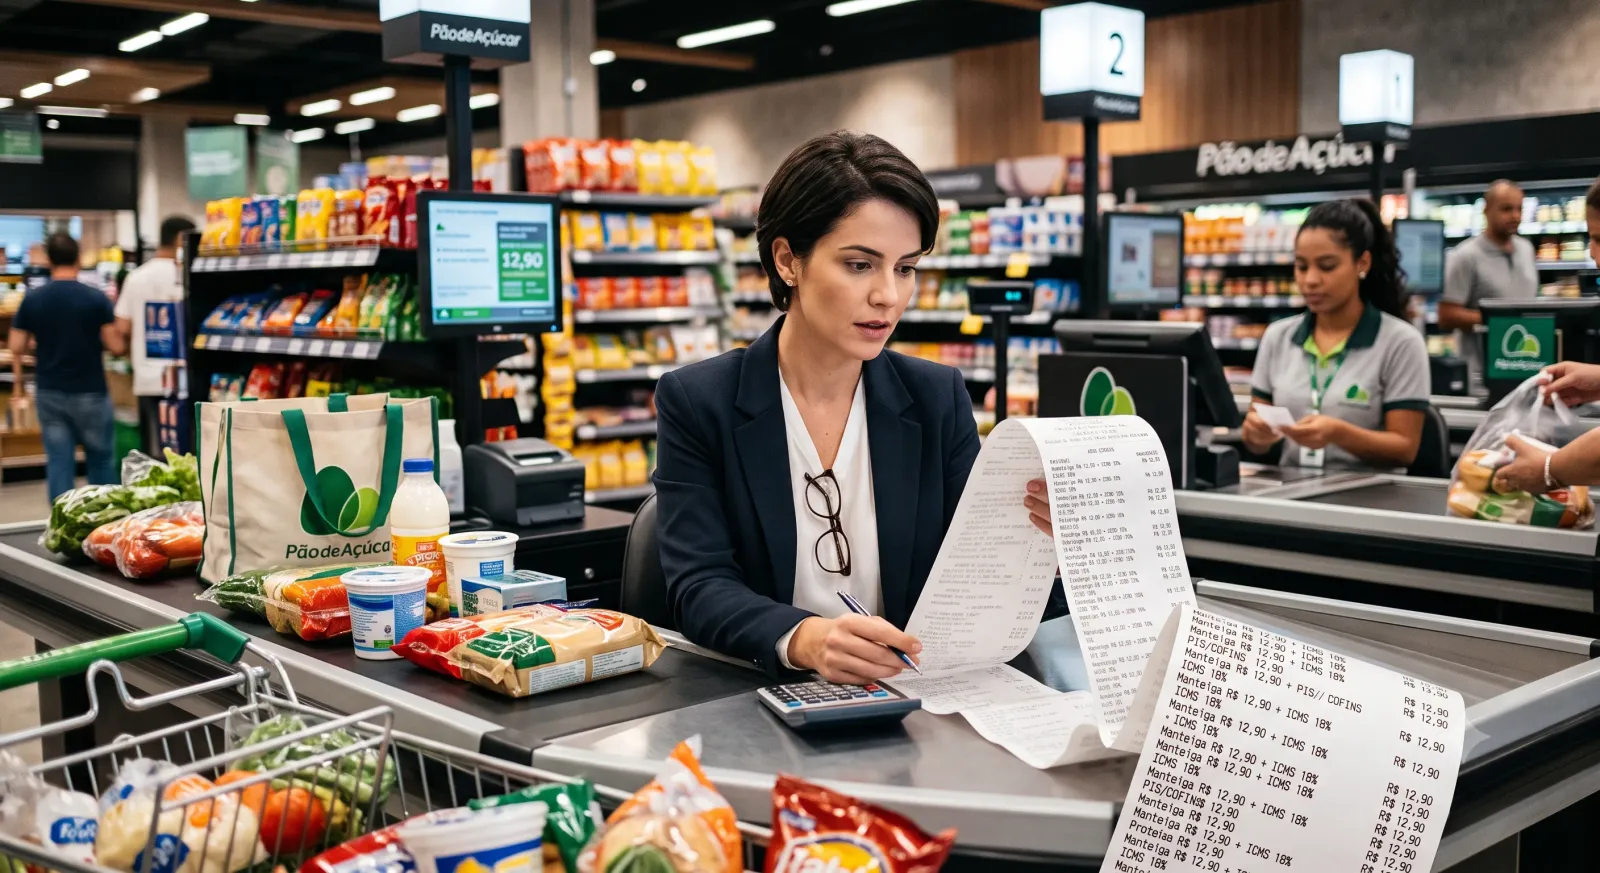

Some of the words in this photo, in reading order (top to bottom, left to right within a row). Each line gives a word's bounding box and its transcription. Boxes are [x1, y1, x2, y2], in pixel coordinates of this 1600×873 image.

[430, 23, 522, 47] PãodeAçúcar
[1110, 33, 1124, 75] 2
[502, 251, 543, 270] 12,90
[286, 540, 391, 559] PãodeAçúca
[1187, 635, 1247, 662] PIS/COFINS
[1256, 658, 1284, 675] 12,90
[1190, 625, 1236, 647] Manteiga
[1241, 642, 1252, 652] R$
[1301, 662, 1323, 676] ICMS
[1329, 671, 1345, 683] 18%
[1192, 616, 1237, 636] Manteiga
[1241, 632, 1254, 642] R$
[1301, 652, 1324, 665] ICMS
[1330, 662, 1346, 673] 18%
[1181, 660, 1206, 675] ICMS
[1211, 669, 1228, 682] 18%
[1185, 647, 1231, 670] Manteiga
[1236, 664, 1248, 676] R$
[1254, 670, 1282, 687] 12,90
[1296, 684, 1325, 701] PIS//
[1327, 694, 1363, 714] COFINS
[1175, 686, 1199, 702] ICMS
[1205, 695, 1221, 709] 18%
[1176, 672, 1222, 695] Manteiga
[1226, 688, 1239, 700] R$
[1244, 694, 1272, 711] 12,90
[1286, 708, 1310, 724] ICMS
[1315, 717, 1332, 731] 18%
[1405, 697, 1416, 707] R$
[1169, 698, 1215, 722] Manteiga
[1220, 715, 1233, 728] R$
[1238, 721, 1267, 738] 12,90
[1281, 735, 1305, 752] ICMS
[1311, 745, 1328, 759] 18%
[1174, 714, 1198, 731] ICMS
[1202, 724, 1220, 738] 18%
[1404, 708, 1415, 718] R$
[1422, 714, 1448, 729] 12,90
[1399, 731, 1412, 743] R$
[1418, 737, 1445, 753] 12,90
[1153, 753, 1178, 769] ICMS
[1184, 762, 1201, 777] 18%
[1160, 725, 1207, 749] Manteiga
[1211, 741, 1224, 754] R$
[1229, 747, 1257, 765] 12,90
[1272, 761, 1296, 778] ICMS
[1301, 771, 1319, 785] 18%
[1156, 739, 1202, 762] Manteiga
[1206, 756, 1219, 768] R$
[1224, 761, 1252, 779] 12,90
[1267, 775, 1292, 791] ICMS
[1296, 784, 1314, 799] 18%
[1394, 756, 1406, 768] R$
[1412, 762, 1440, 779] 12,90
[1147, 766, 1194, 790] Manteiga
[1199, 782, 1211, 795] R$
[1217, 786, 1246, 806] 12,90
[1261, 803, 1286, 819] ICMS
[1290, 813, 1308, 827] 18%
[1387, 782, 1399, 795] R$
[1405, 789, 1433, 806] 12,90
[1138, 793, 1185, 817] Manteiga
[1189, 810, 1202, 822] R$
[1206, 815, 1235, 833] 12,90
[1211, 802, 1240, 819] 12,90
[1382, 796, 1395, 809] R$
[1401, 803, 1429, 819] 12,90
[1378, 810, 1391, 822] R$
[1397, 816, 1425, 833] 12,90
[1133, 806, 1181, 831] Manteiga
[1185, 823, 1198, 836] R$
[1203, 829, 1231, 847] 12,90
[1246, 843, 1271, 860] ICMS
[1275, 853, 1293, 867] 18%
[1374, 824, 1387, 836] R$
[1393, 830, 1421, 846] 12,90
[1120, 847, 1145, 863] ICMS
[1150, 857, 1168, 871] 18%
[1124, 833, 1170, 857] Manteiga
[1174, 850, 1187, 862] R$
[1192, 856, 1220, 873] 12,90
[1177, 836, 1191, 848] R$
[1195, 842, 1224, 859] 12,90
[1370, 837, 1383, 849] R$
[1389, 844, 1416, 860] 12,90
[1366, 851, 1379, 863] R$
[1384, 857, 1412, 873] 12,90
